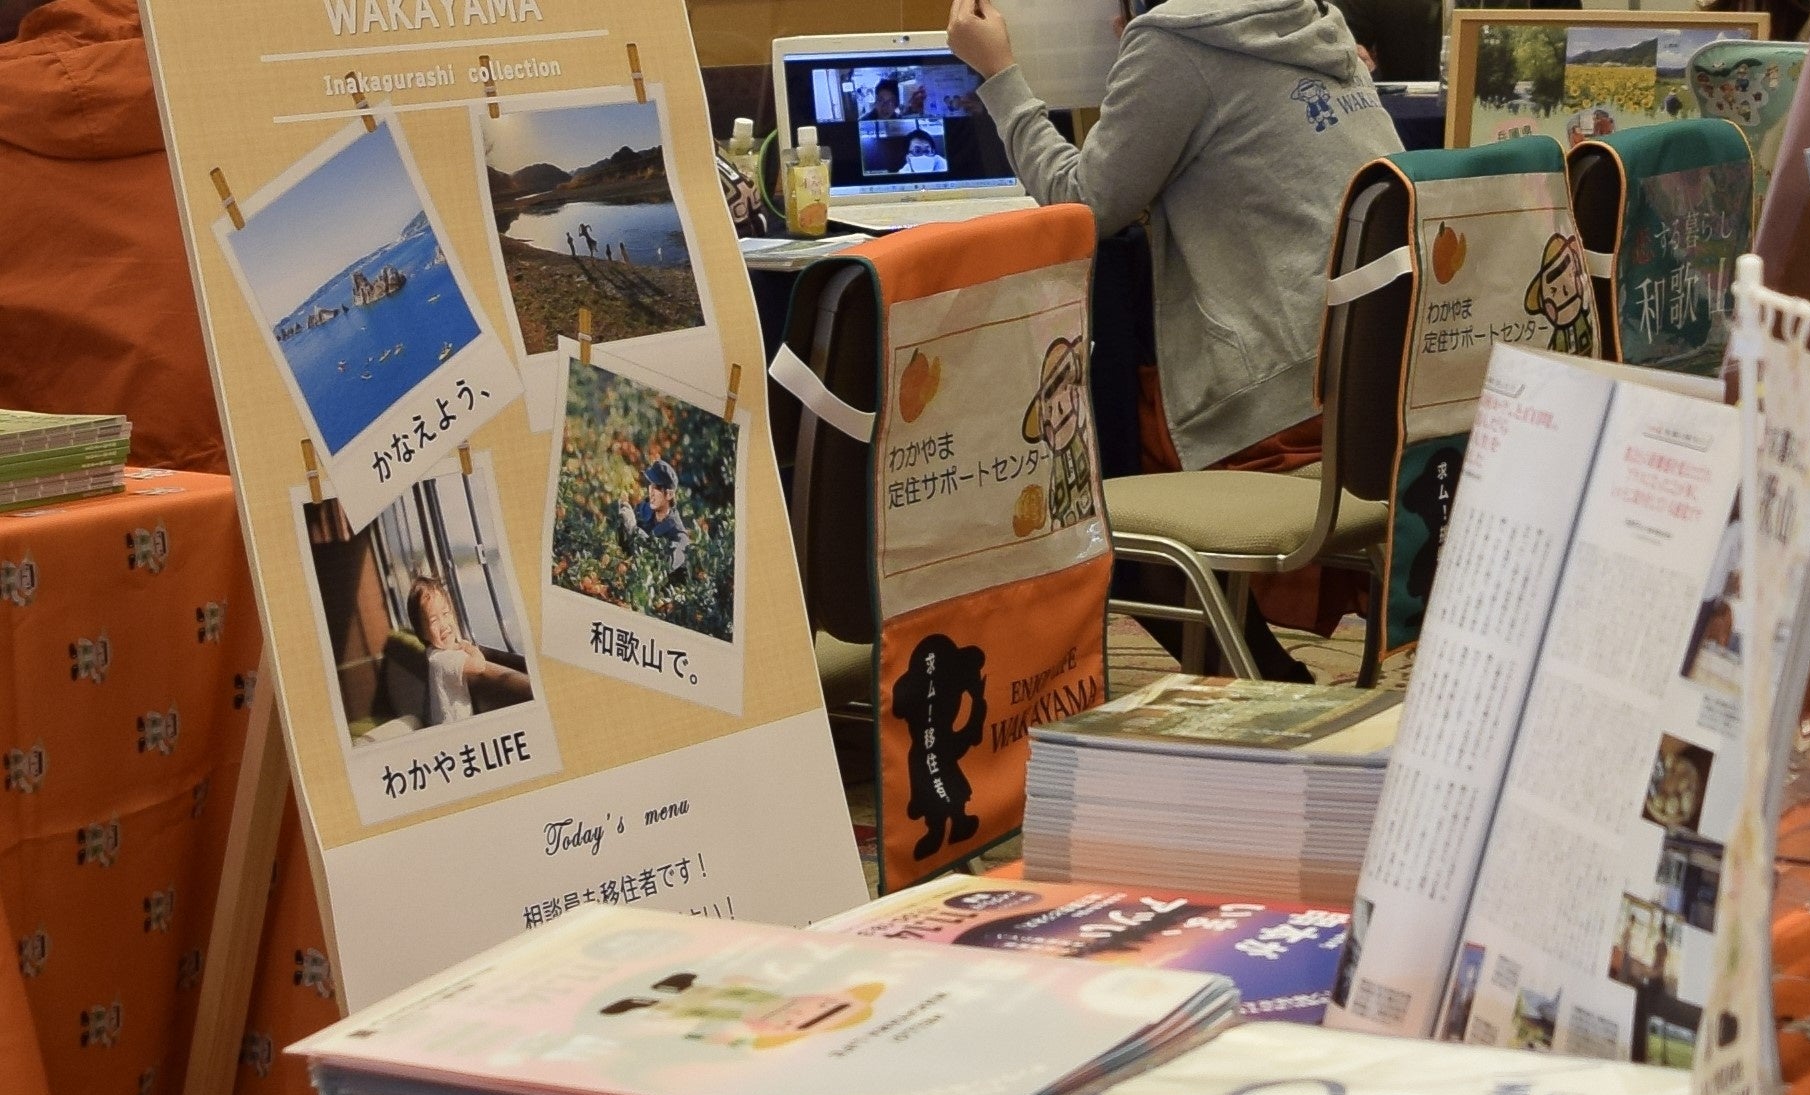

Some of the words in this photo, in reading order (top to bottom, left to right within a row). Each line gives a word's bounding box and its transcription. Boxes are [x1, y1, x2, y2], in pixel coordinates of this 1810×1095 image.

[325, 0, 543, 36] WAKAYAMA
[324, 65, 455, 96] Inakagurashi
[469, 58, 562, 84] collection
[1427, 297, 1473, 325] わかやま
[1422, 321, 1549, 356] 定住サポートセンター
[371, 379, 492, 485] かなえよう、
[888, 431, 956, 474] わかやま
[888, 446, 1051, 511] 定住サポートセンター
[589, 620, 699, 686] 和歌山で。
[381, 730, 532, 799] わかやまLIFE
[543, 813, 626, 856] Today's
[644, 799, 691, 827] menu
